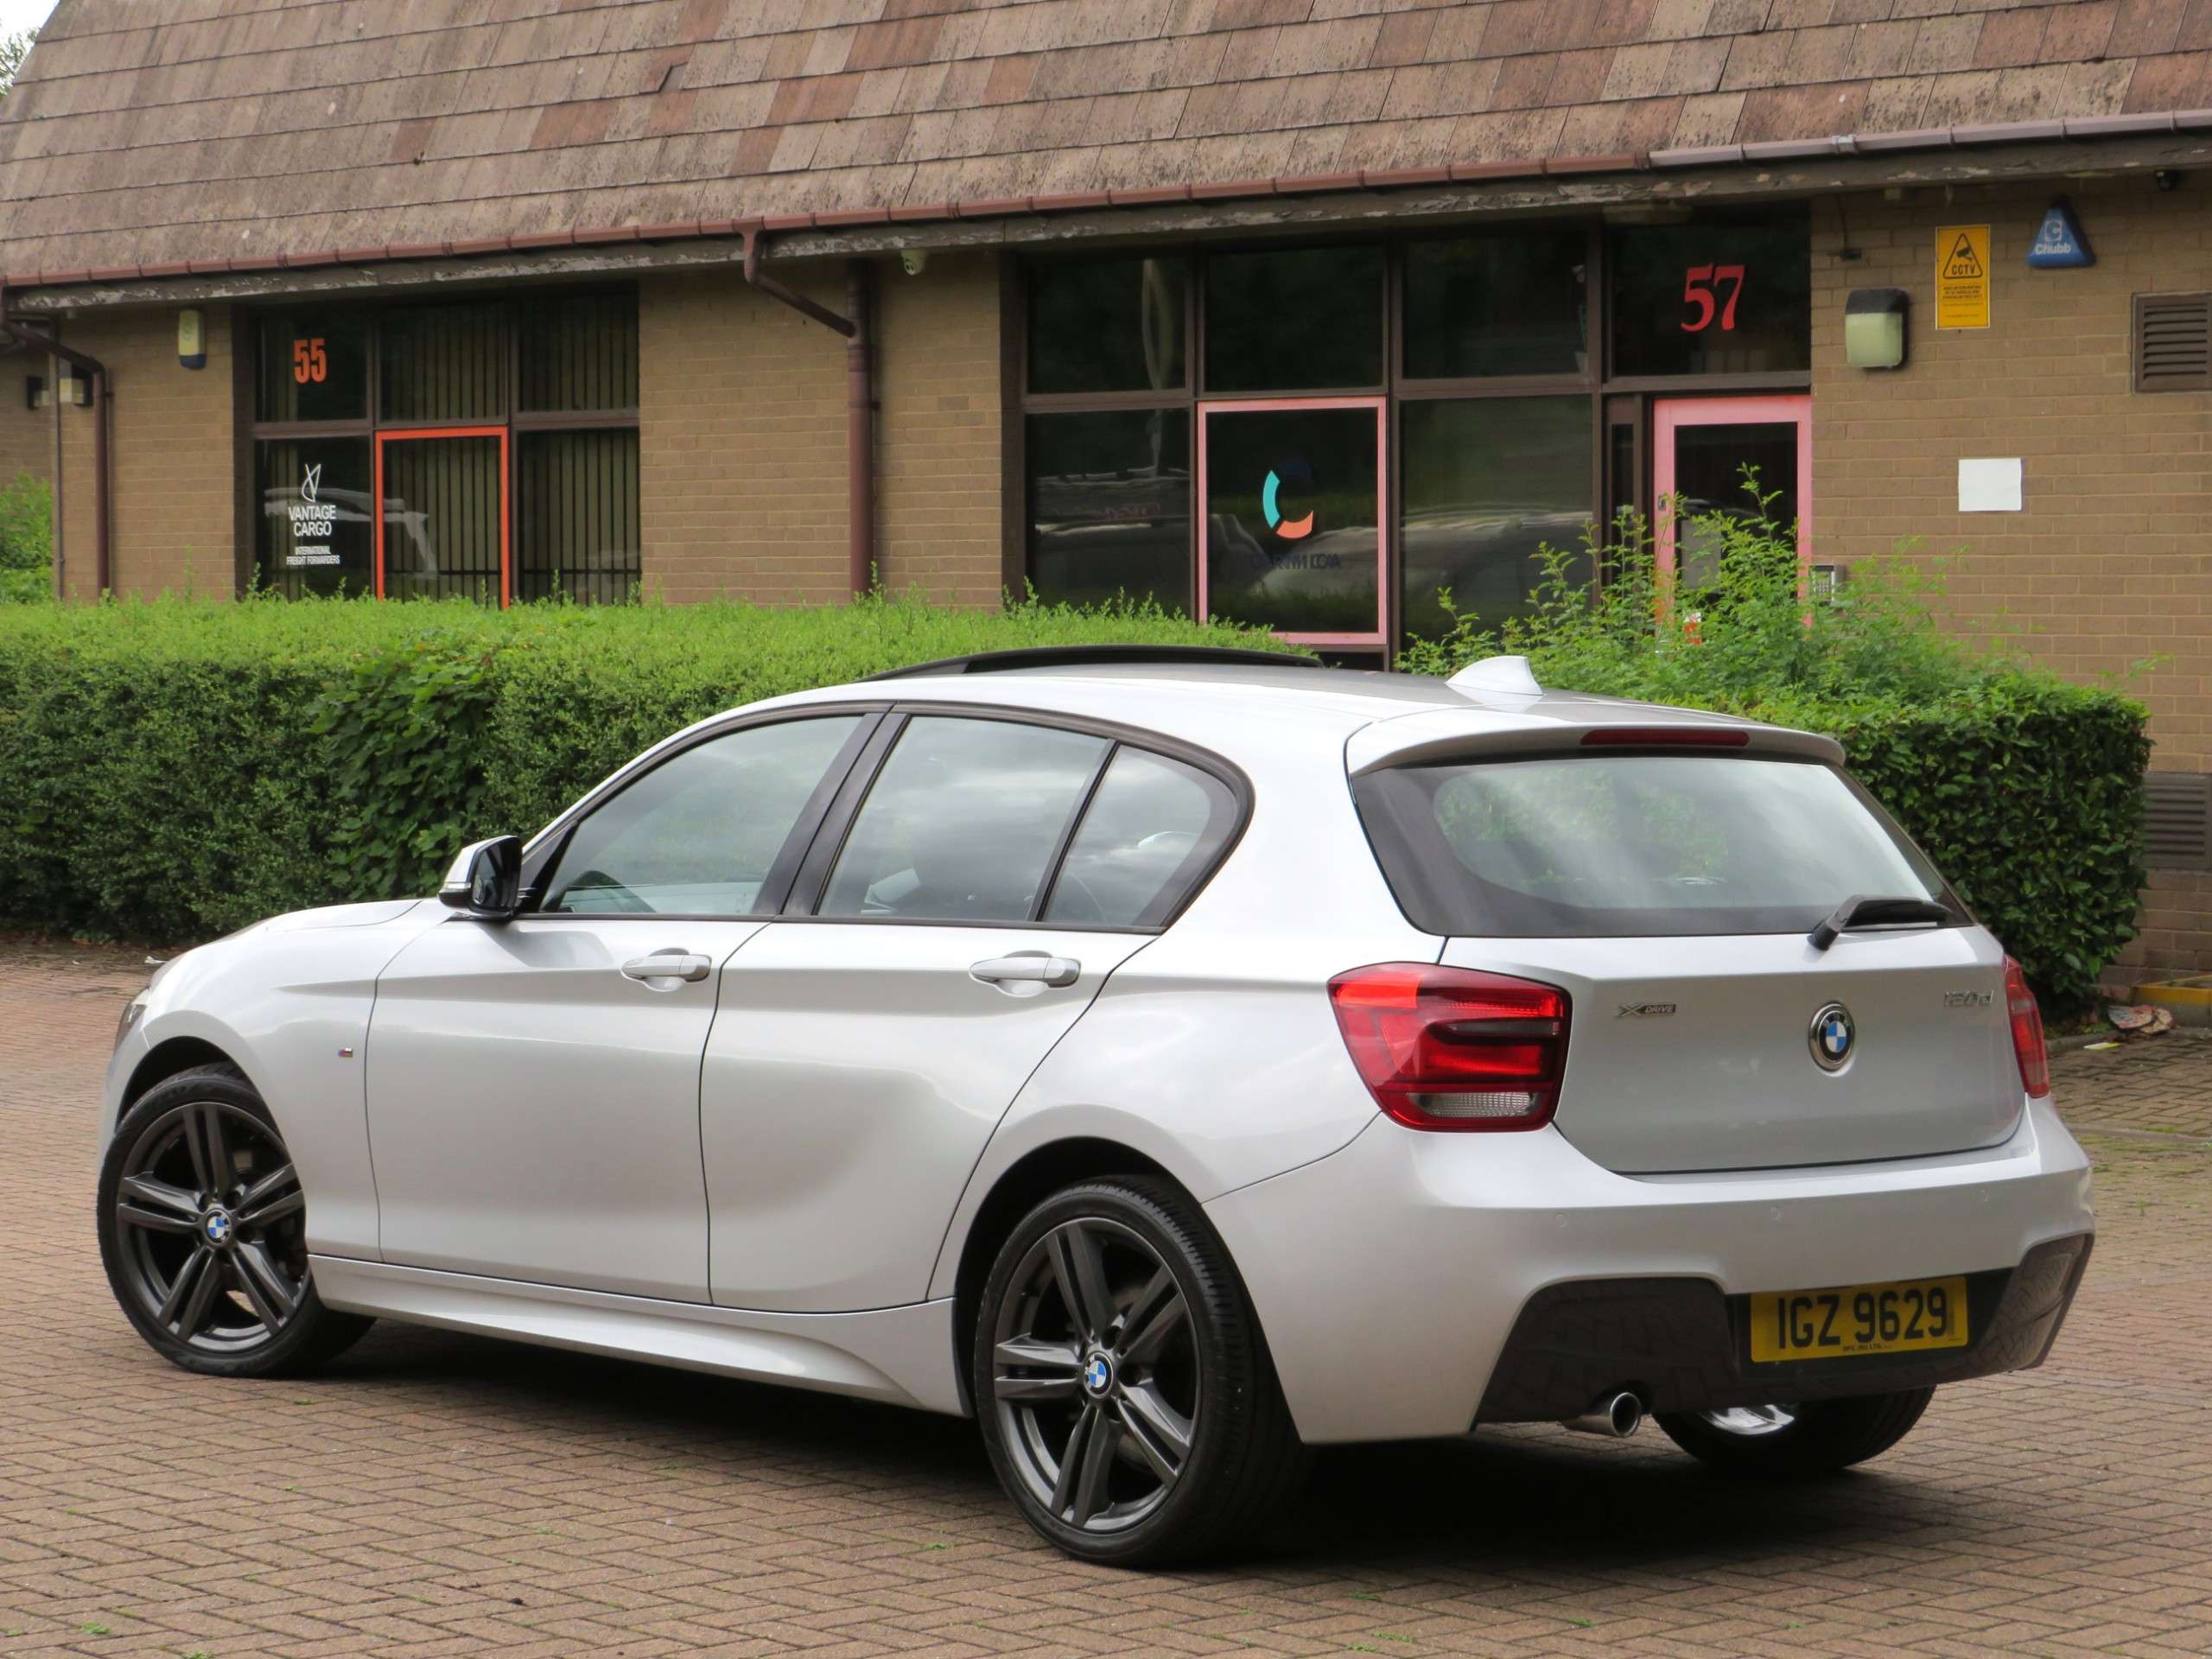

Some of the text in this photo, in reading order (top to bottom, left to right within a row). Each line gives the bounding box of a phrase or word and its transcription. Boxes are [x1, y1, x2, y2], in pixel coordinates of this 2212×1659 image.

[2034, 242, 2072, 255] Chubb
[1951, 263, 1976, 276] CCTV
[1681, 263, 1745, 332] 57
[294, 338, 327, 384] 55
[288, 505, 337, 521] VANTAGE
[294, 520, 333, 537] CARGO
[1777, 1287, 1948, 1349] IGZ 9629
